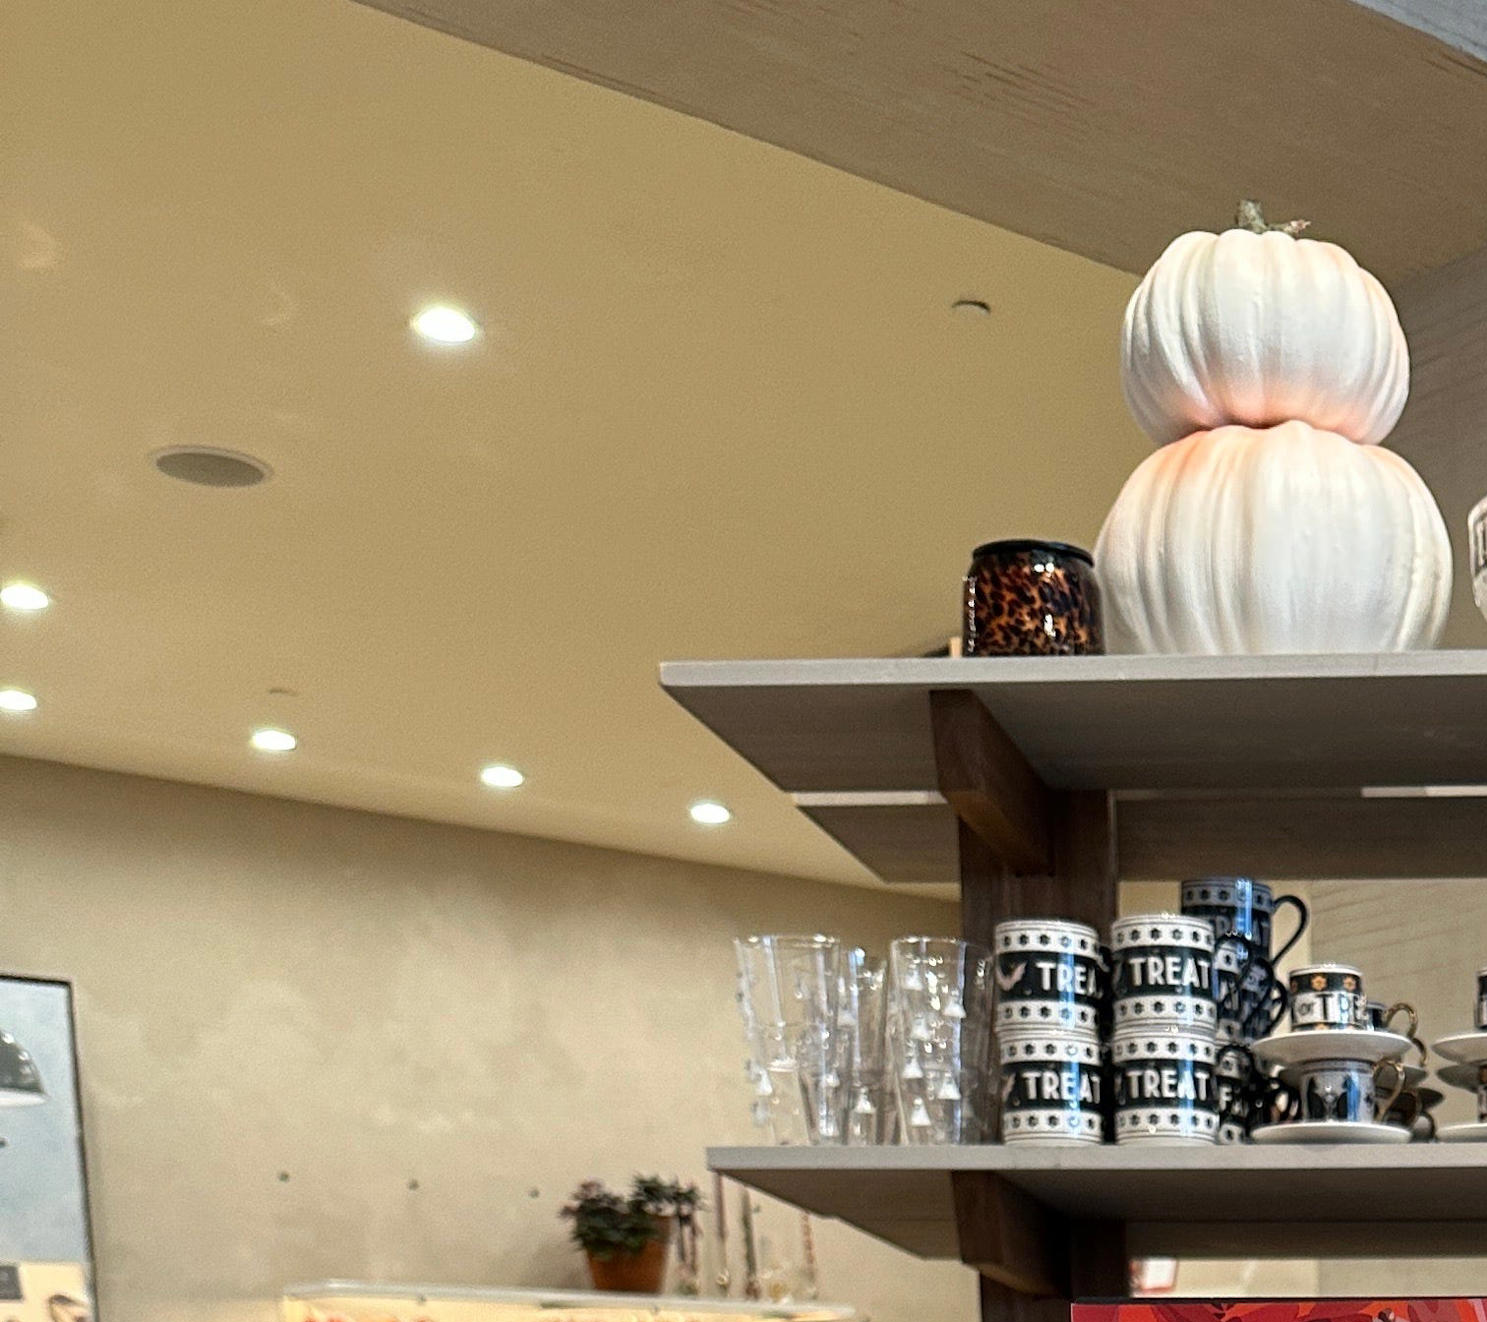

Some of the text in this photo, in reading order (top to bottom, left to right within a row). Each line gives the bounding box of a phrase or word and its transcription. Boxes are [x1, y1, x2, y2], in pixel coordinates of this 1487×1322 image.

[1128, 956, 1211, 990] TREAT
[1021, 1070, 1101, 1104] TREAT
[1126, 1069, 1210, 1101] TREAT
